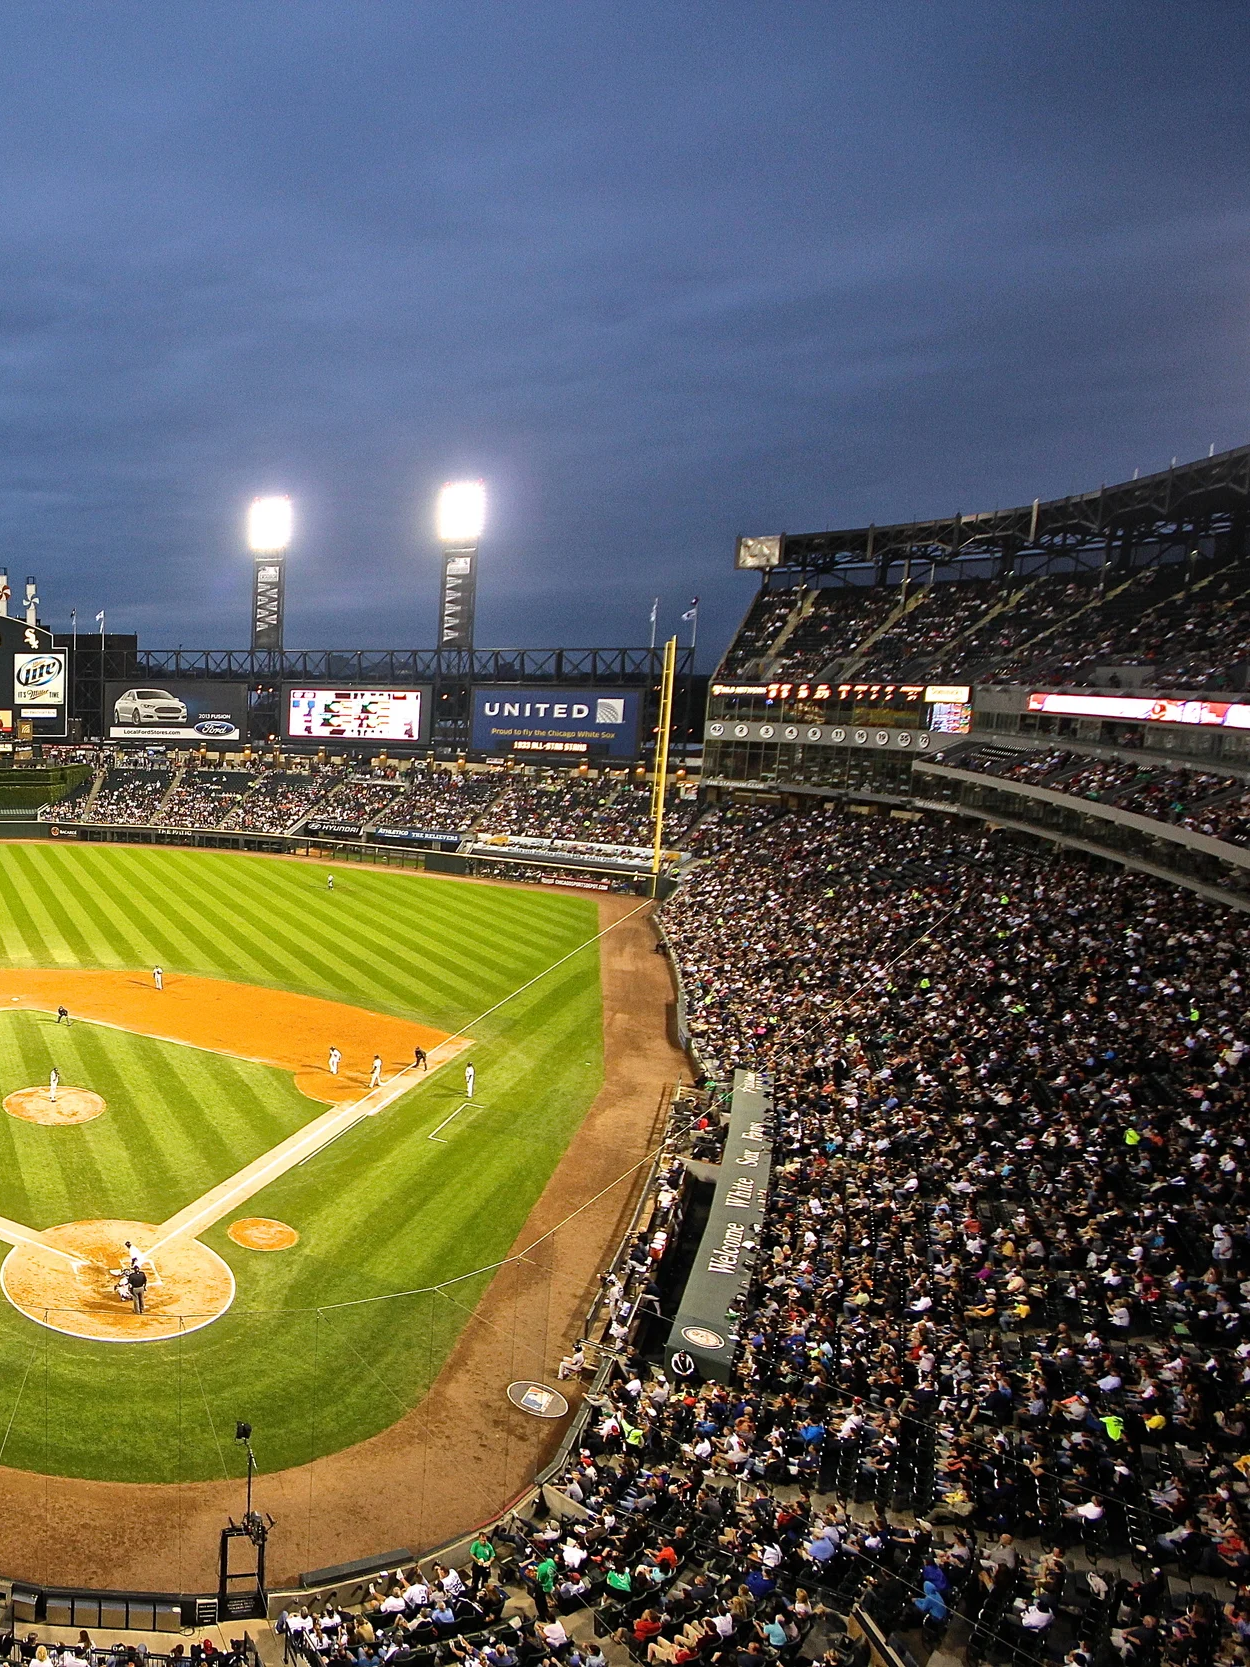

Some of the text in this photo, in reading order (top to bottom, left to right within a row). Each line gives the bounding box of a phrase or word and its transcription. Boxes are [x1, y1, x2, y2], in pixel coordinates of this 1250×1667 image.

[483, 702, 590, 718] UNITED
[201, 723, 227, 734] Ford
[547, 730, 576, 738] Chicago
[322, 824, 359, 833] HYUNDAI
[736, 1149, 760, 1168] Sox
[725, 1176, 754, 1208] White
[708, 1222, 745, 1274] Welcome
